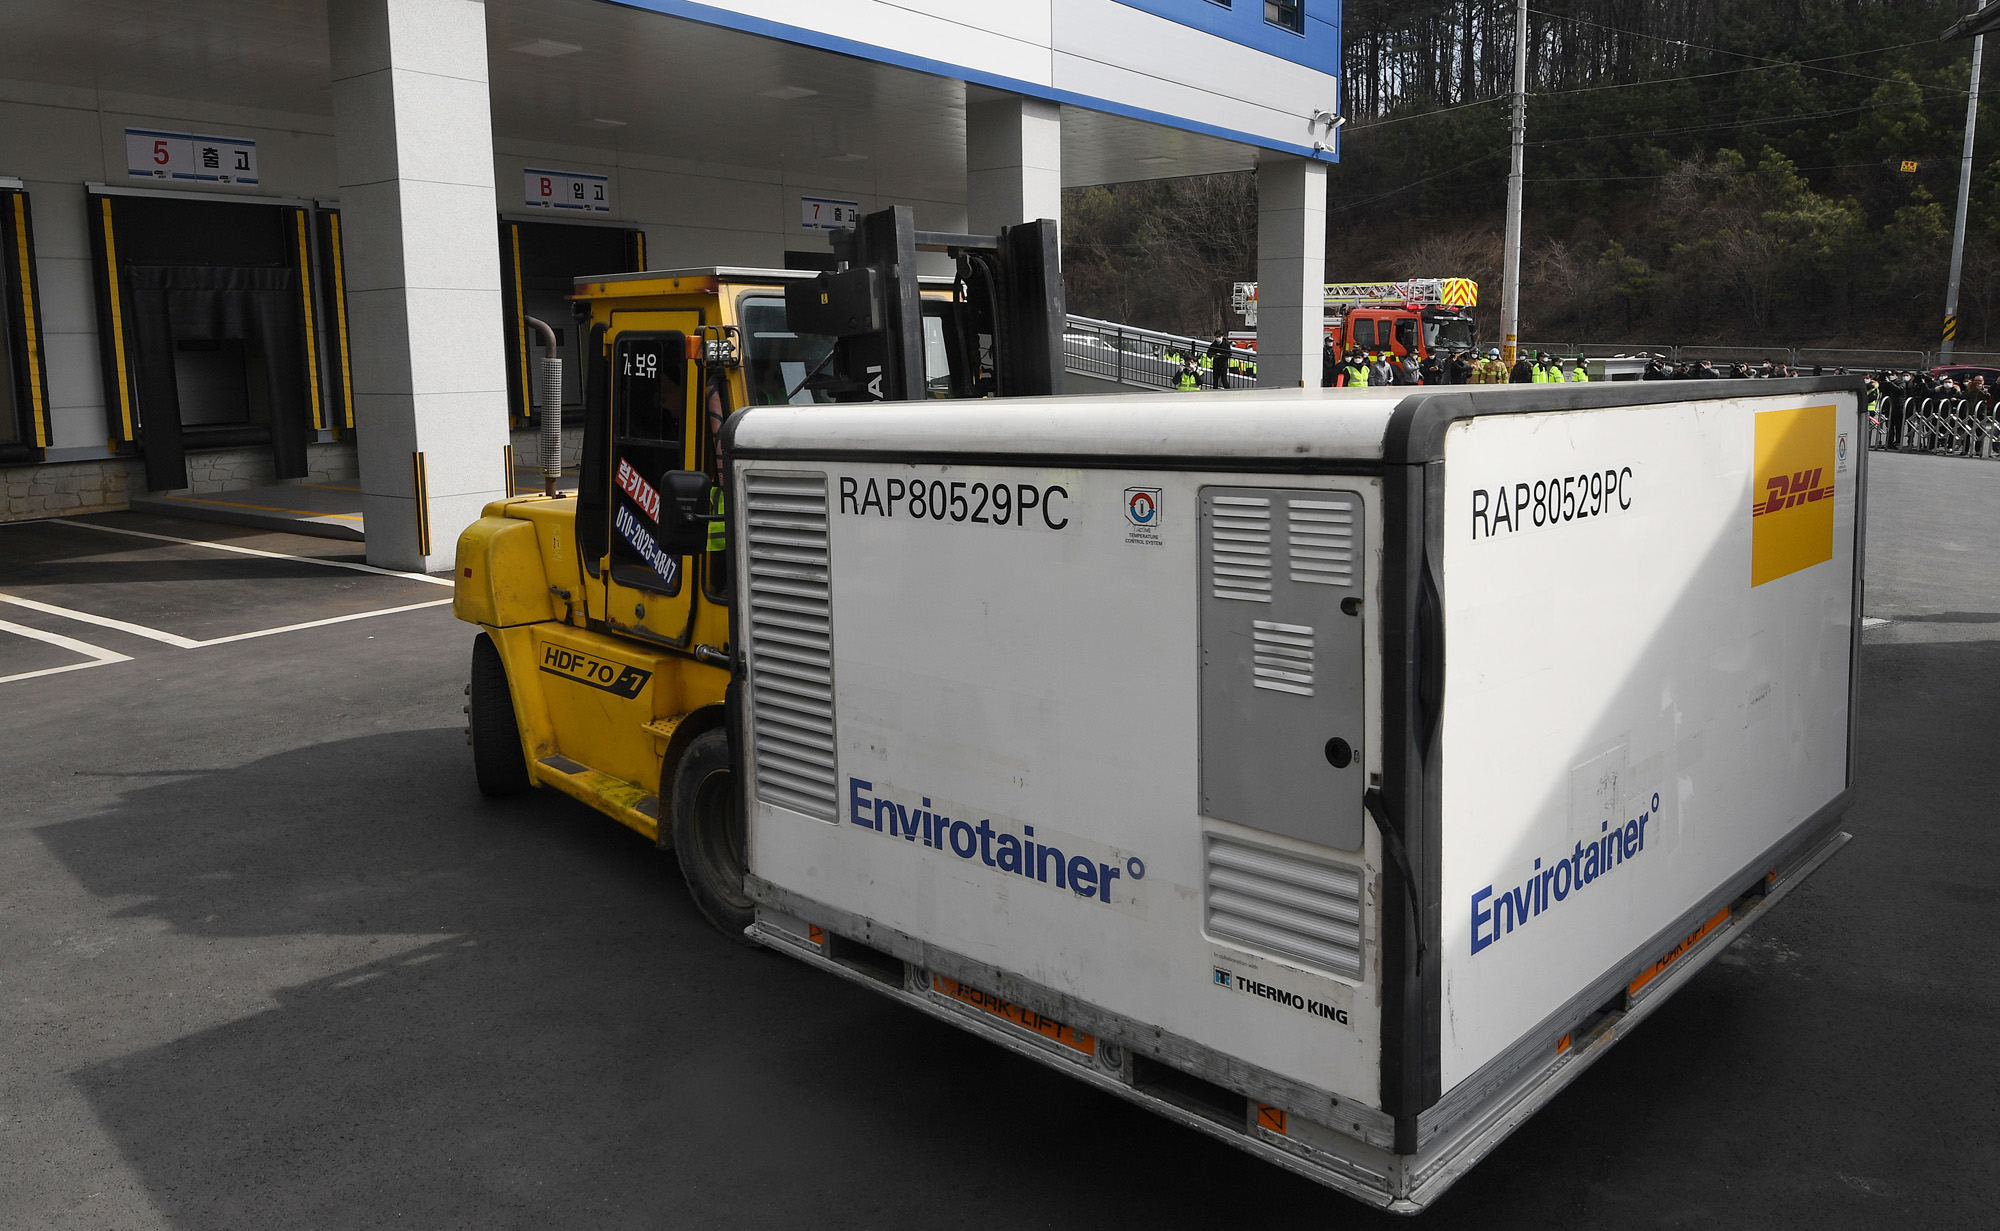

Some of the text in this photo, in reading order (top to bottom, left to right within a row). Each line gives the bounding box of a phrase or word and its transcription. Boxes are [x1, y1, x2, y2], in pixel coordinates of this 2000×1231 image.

[153, 140, 170, 165] 5
[540, 177, 552, 197] B
[813, 203, 820, 219] 7
[635, 353, 657, 379] 보유
[866, 365, 884, 402] AI
[839, 476, 1069, 530] RAP80529PC
[1472, 466, 1633, 540] RAP80529PC
[1764, 467, 1825, 515] DHL
[616, 505, 677, 584] 010-2025-4847
[544, 646, 585, 672] HDF
[587, 660, 614, 683] 70
[958, 983, 1067, 1038] FORK LIFT
[1236, 975, 1348, 1025] THERMO KING
